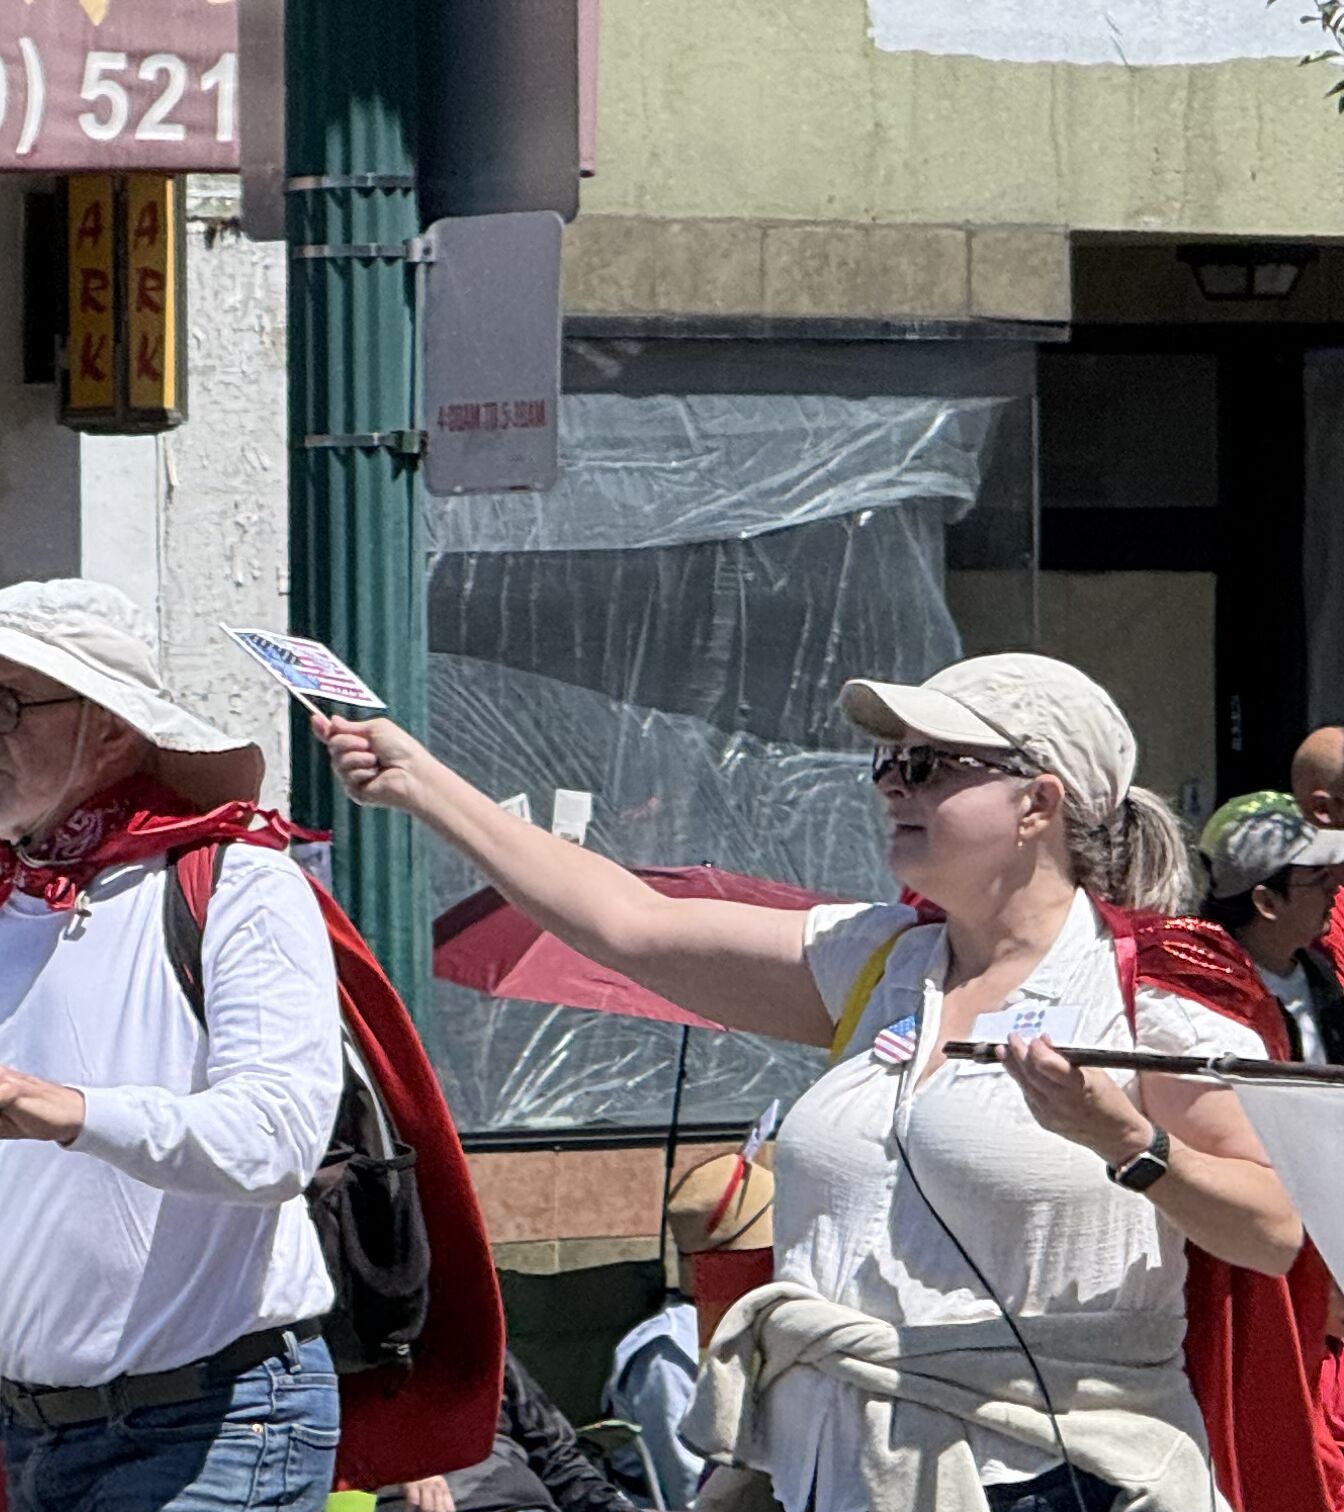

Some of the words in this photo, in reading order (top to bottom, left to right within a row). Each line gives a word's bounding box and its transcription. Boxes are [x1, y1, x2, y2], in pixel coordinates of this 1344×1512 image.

[78, 47, 239, 142] 521
[75, 200, 112, 385] ARK
[134, 200, 167, 384] ARK
